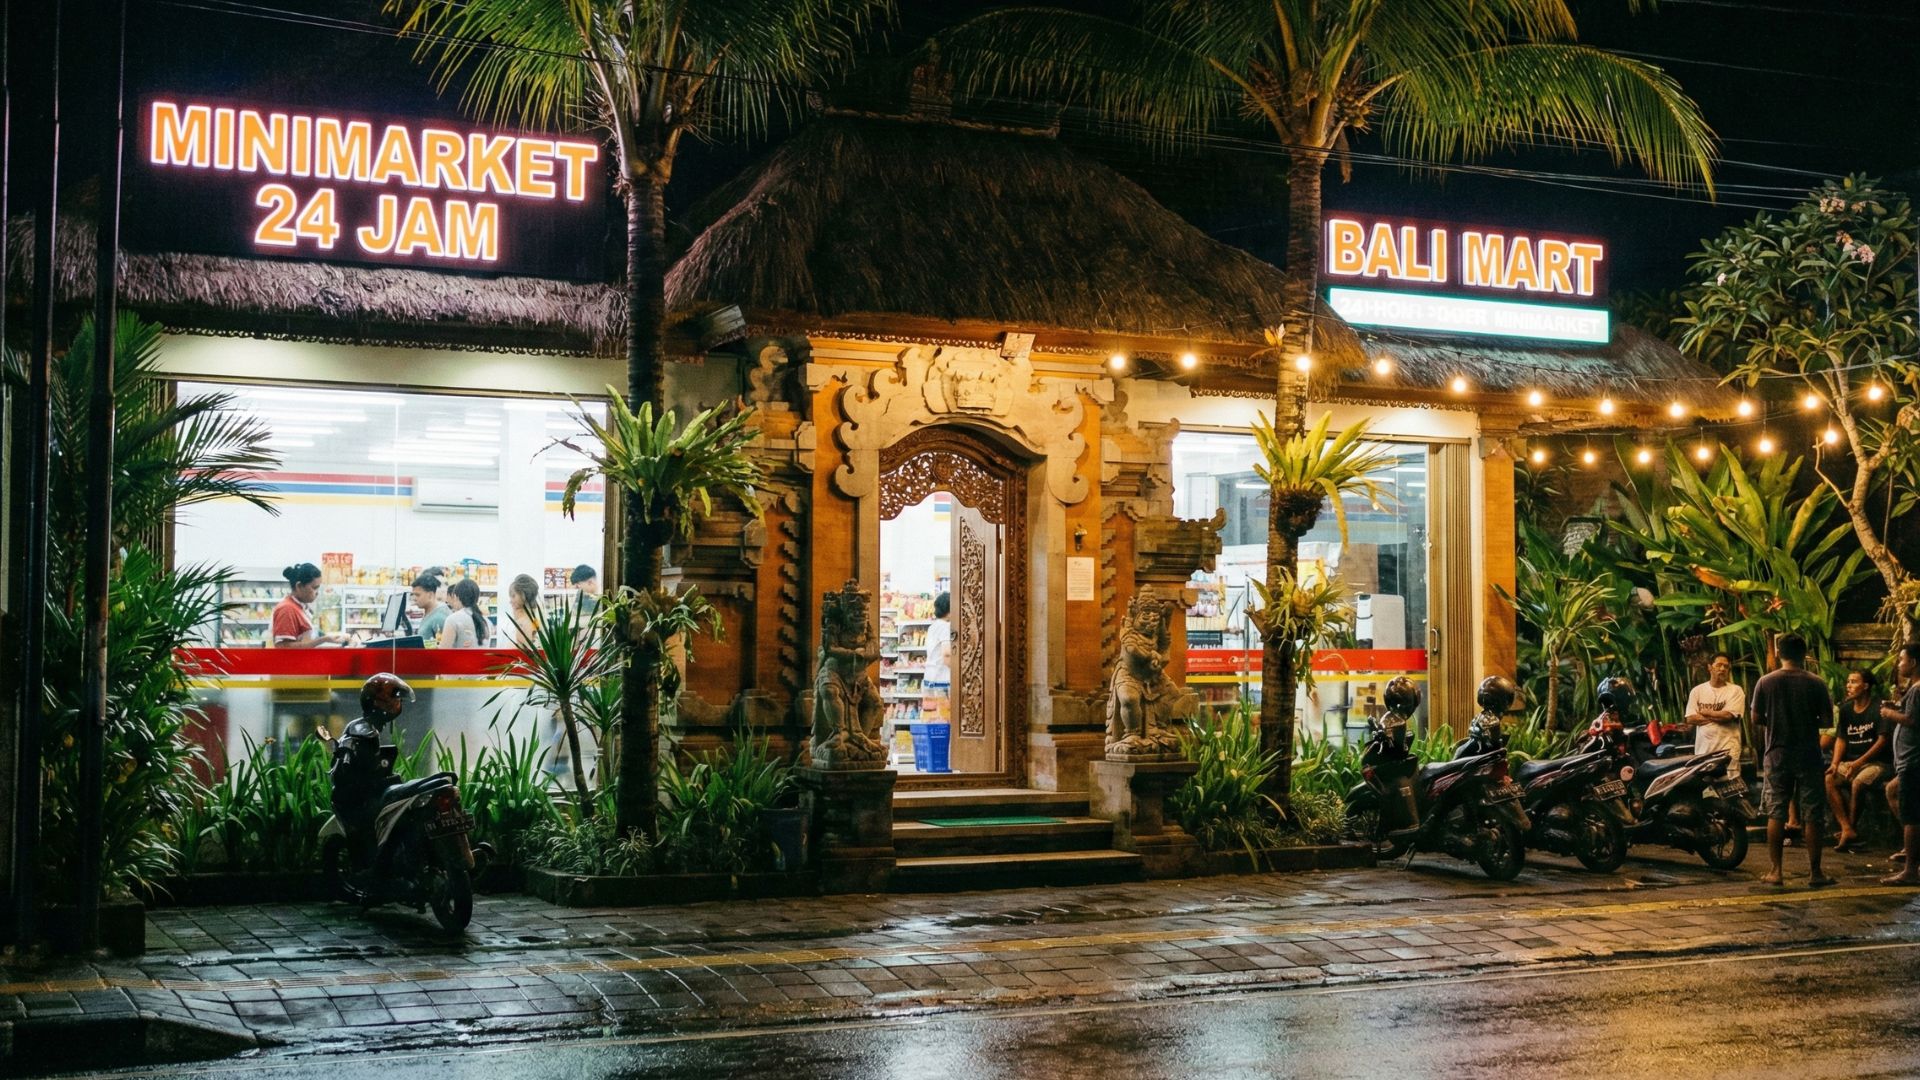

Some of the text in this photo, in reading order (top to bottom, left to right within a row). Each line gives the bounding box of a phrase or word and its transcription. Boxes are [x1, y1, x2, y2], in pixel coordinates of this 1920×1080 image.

[151, 101, 599, 201] MINIMARKET
[254, 183, 500, 262] 24 JAM
[1326, 217, 1603, 296] BALI MART
[1494, 309, 1601, 334] MINIMARKET
